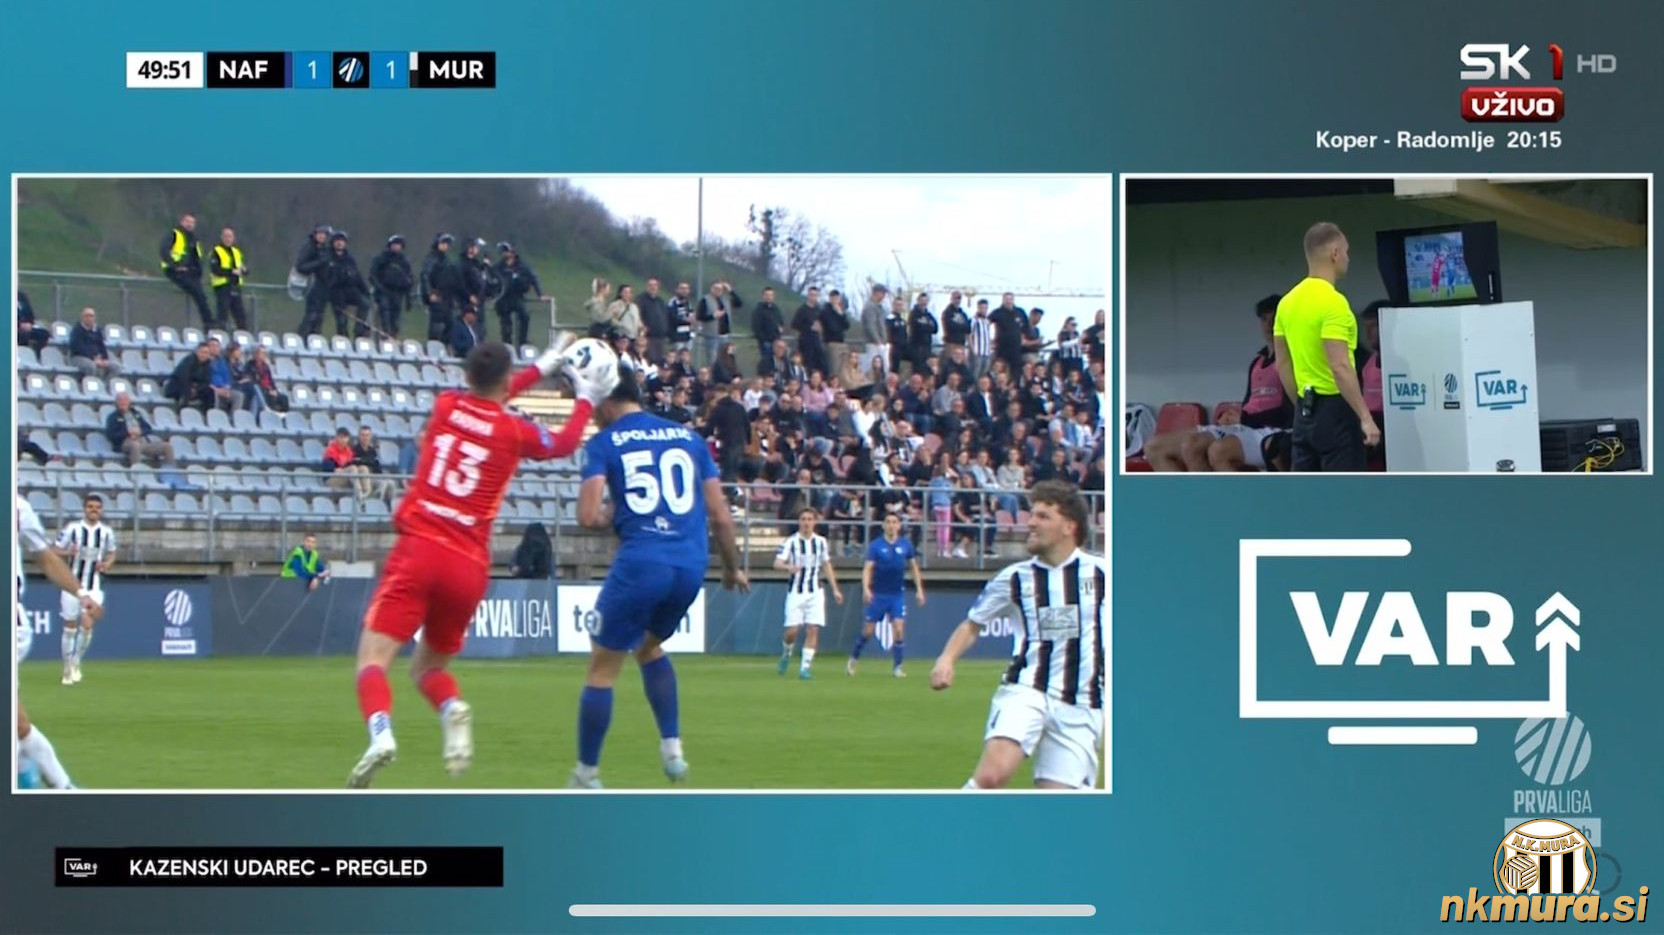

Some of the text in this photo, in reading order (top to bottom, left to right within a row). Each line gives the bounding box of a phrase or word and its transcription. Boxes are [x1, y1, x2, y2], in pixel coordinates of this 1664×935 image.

[1394, 382, 1419, 397] VAR
[1484, 380, 1517, 396] VAR
[426, 433, 491, 497] 13
[621, 447, 695, 515] 50
